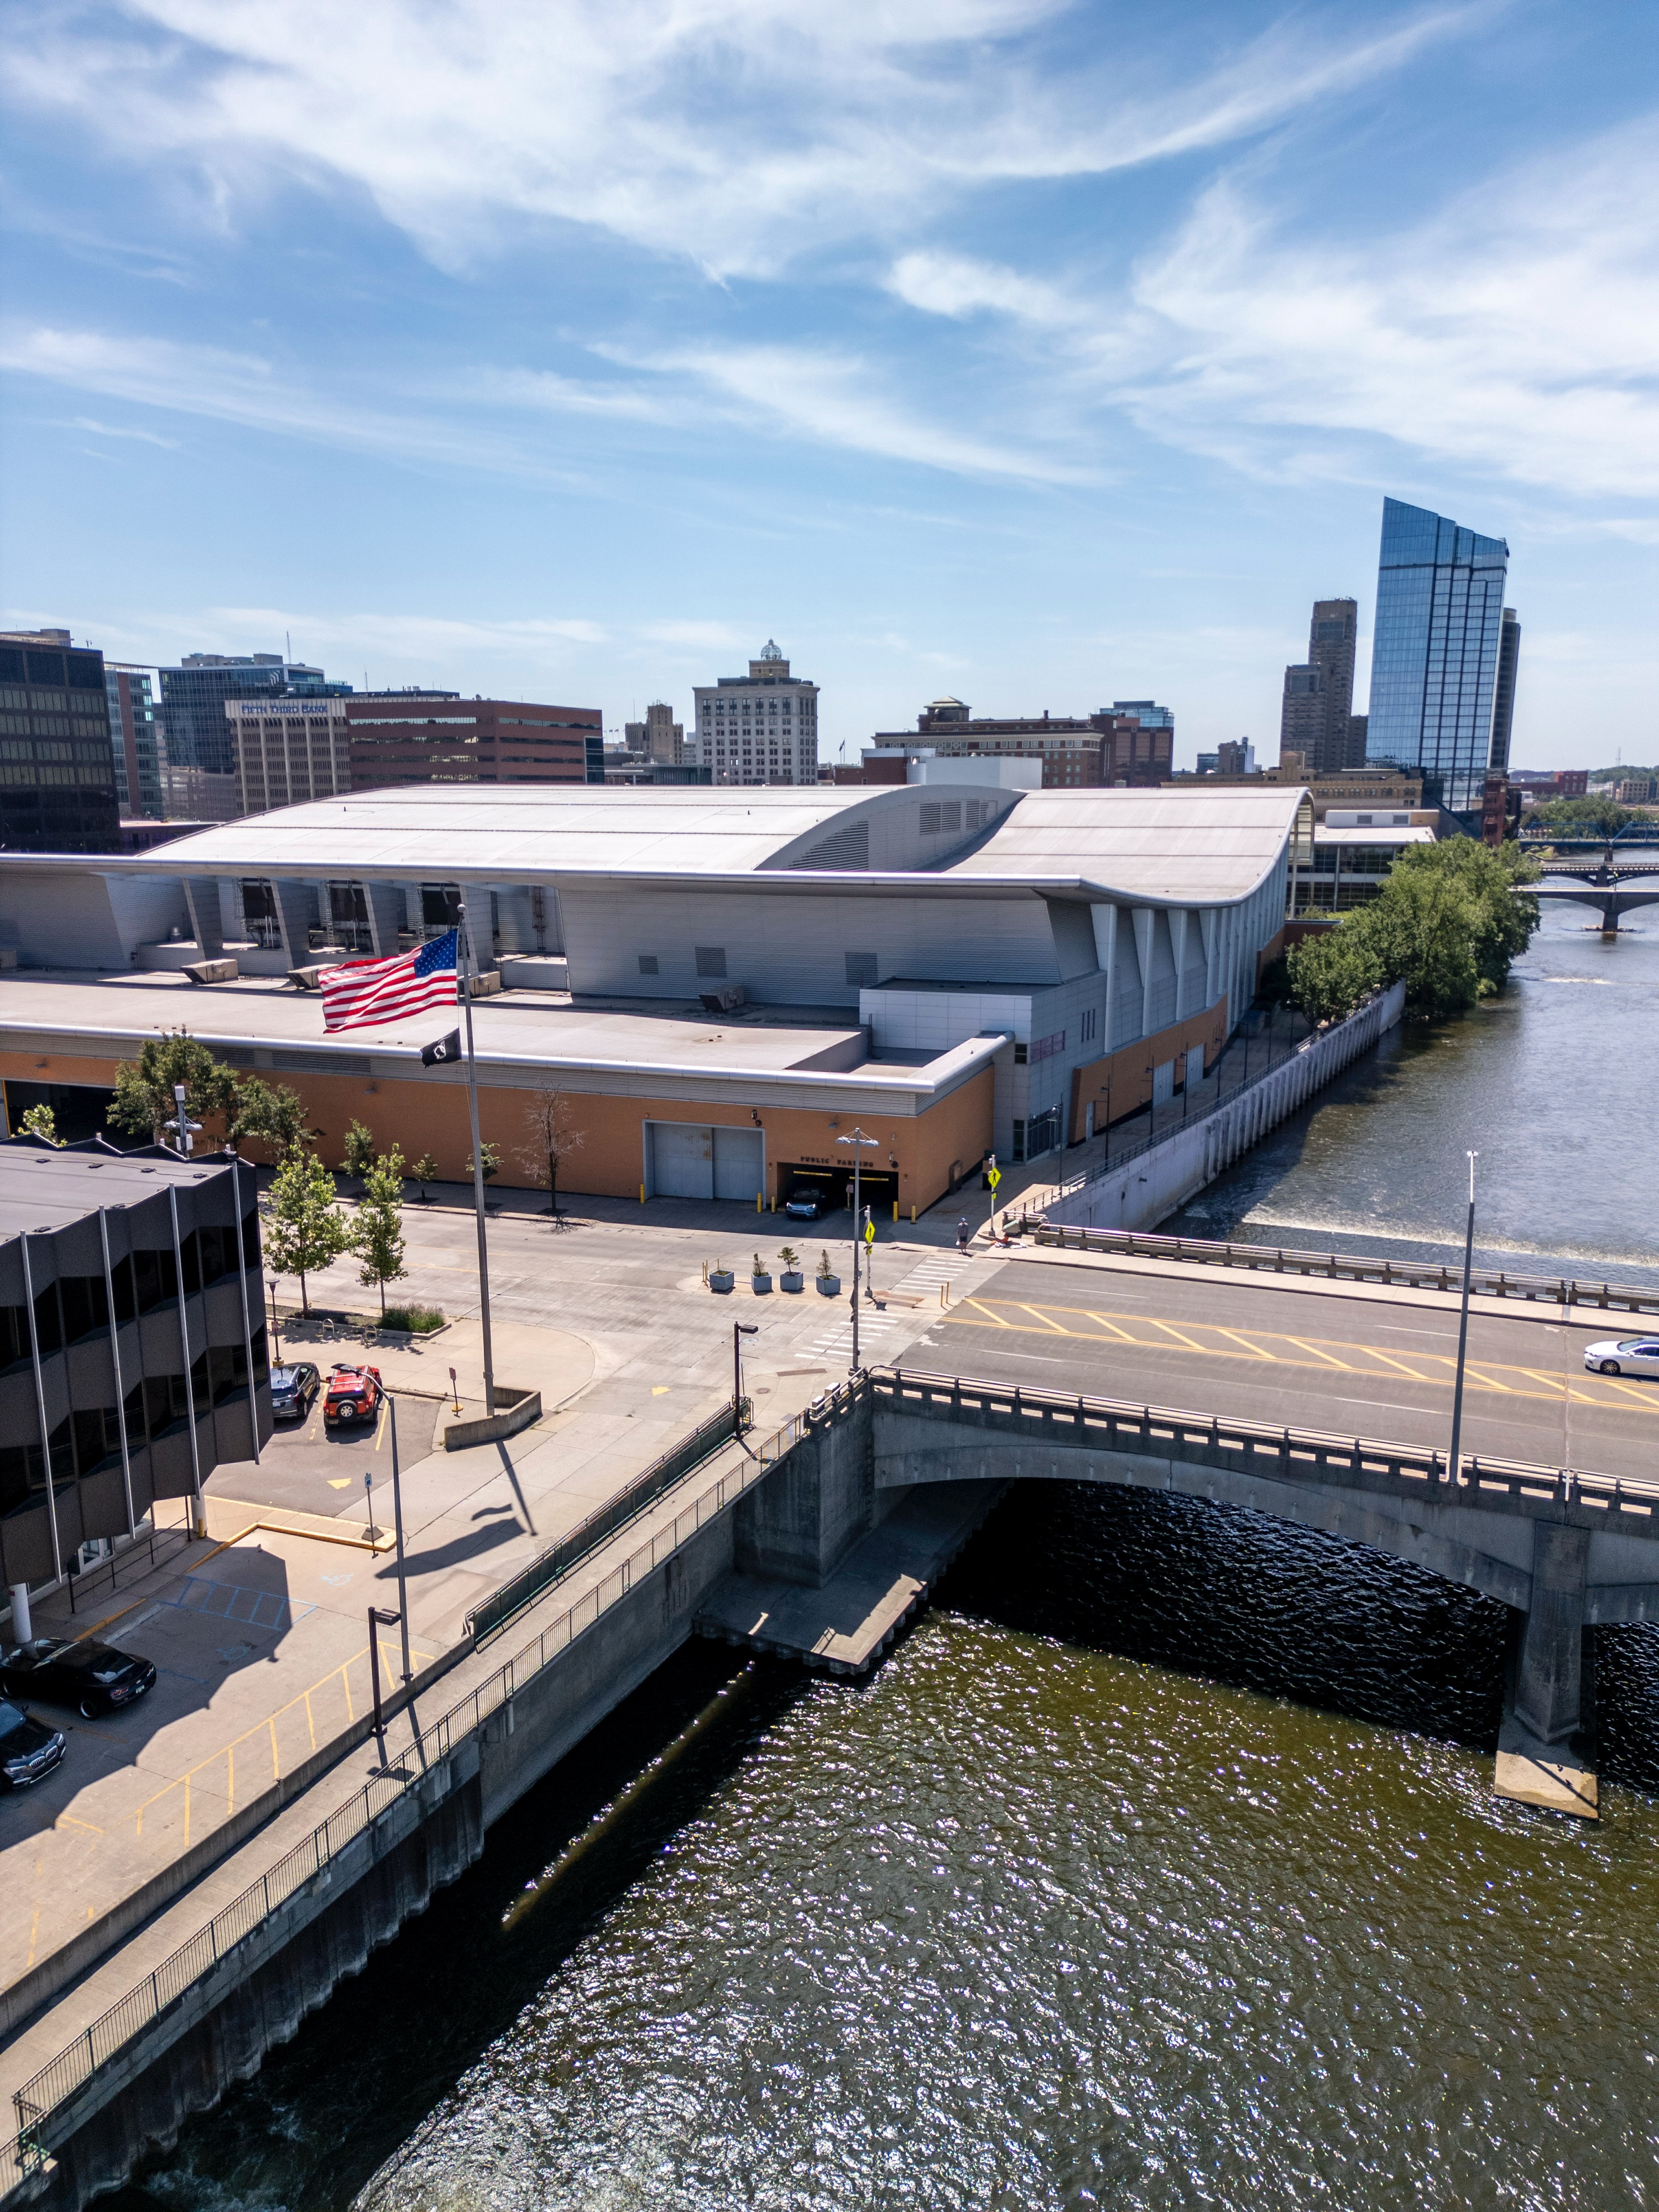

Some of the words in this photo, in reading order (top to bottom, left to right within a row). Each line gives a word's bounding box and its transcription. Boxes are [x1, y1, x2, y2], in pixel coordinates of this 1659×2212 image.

[242, 705, 267, 713] FIFTH
[269, 705, 299, 713] THIRD
[301, 704, 328, 713] BANK
